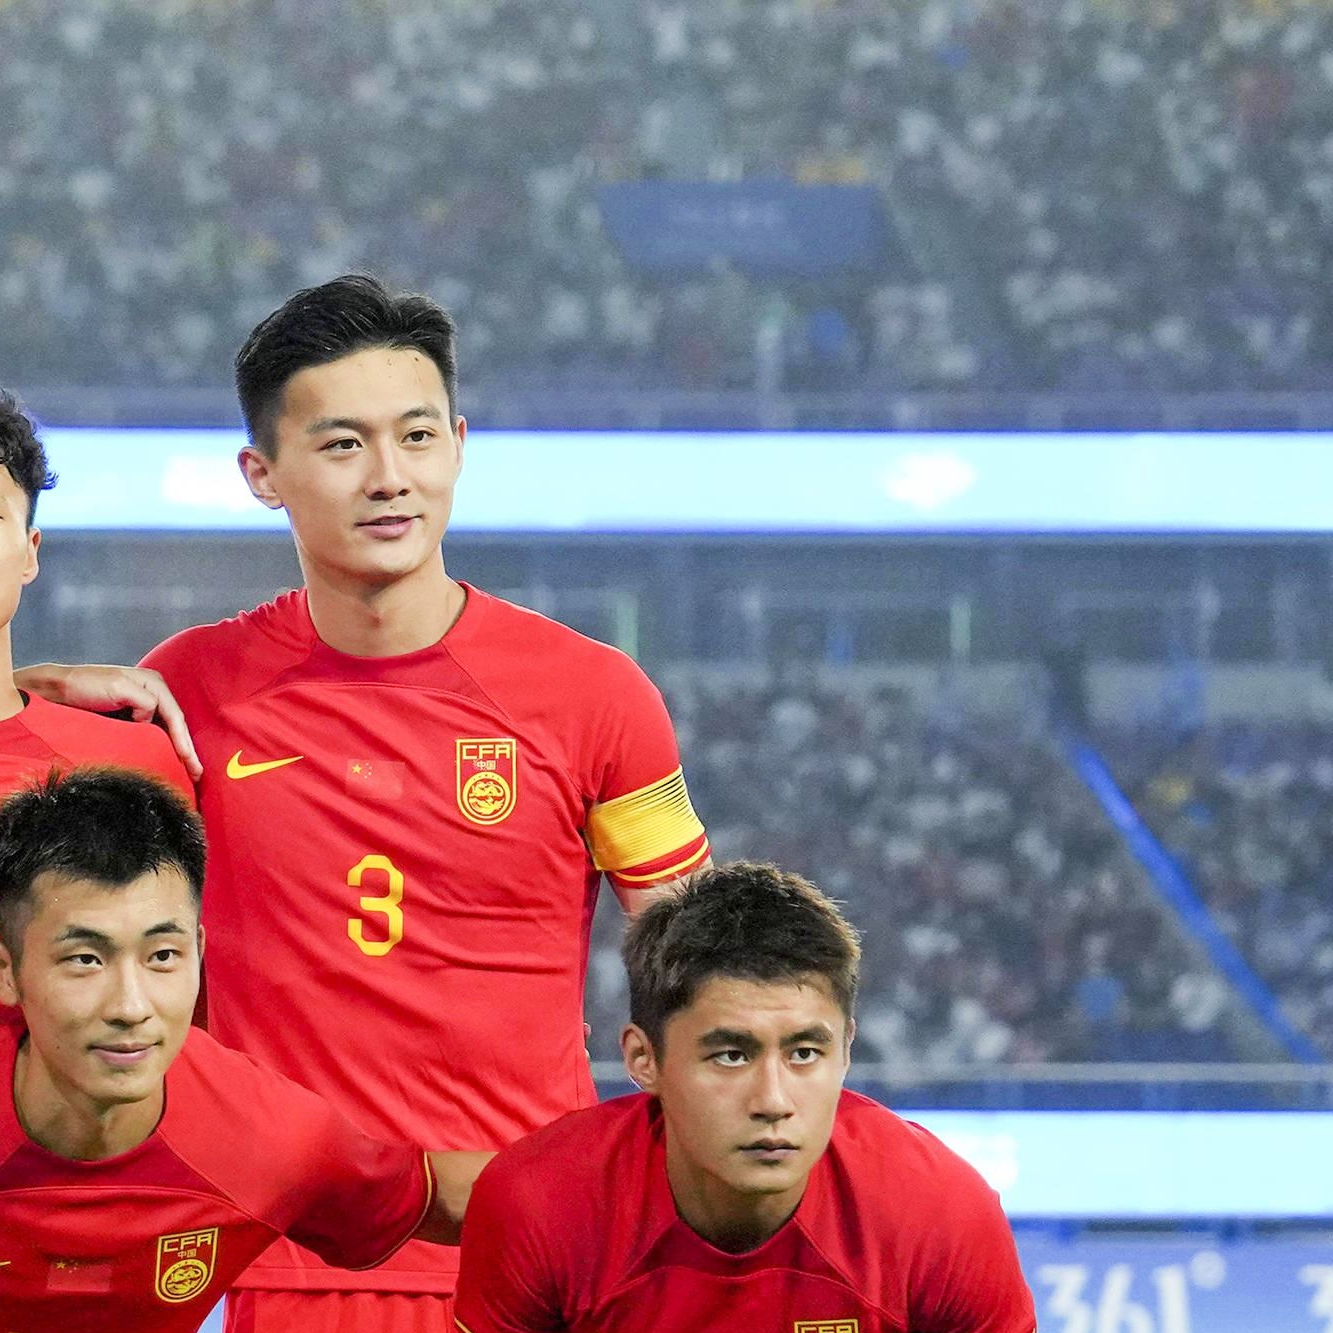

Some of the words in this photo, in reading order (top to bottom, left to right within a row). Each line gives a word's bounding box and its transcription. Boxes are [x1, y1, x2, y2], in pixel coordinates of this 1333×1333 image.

[462, 744, 510, 760] CFA
[347, 854, 404, 957] 3
[164, 1233, 212, 1252] CFA
